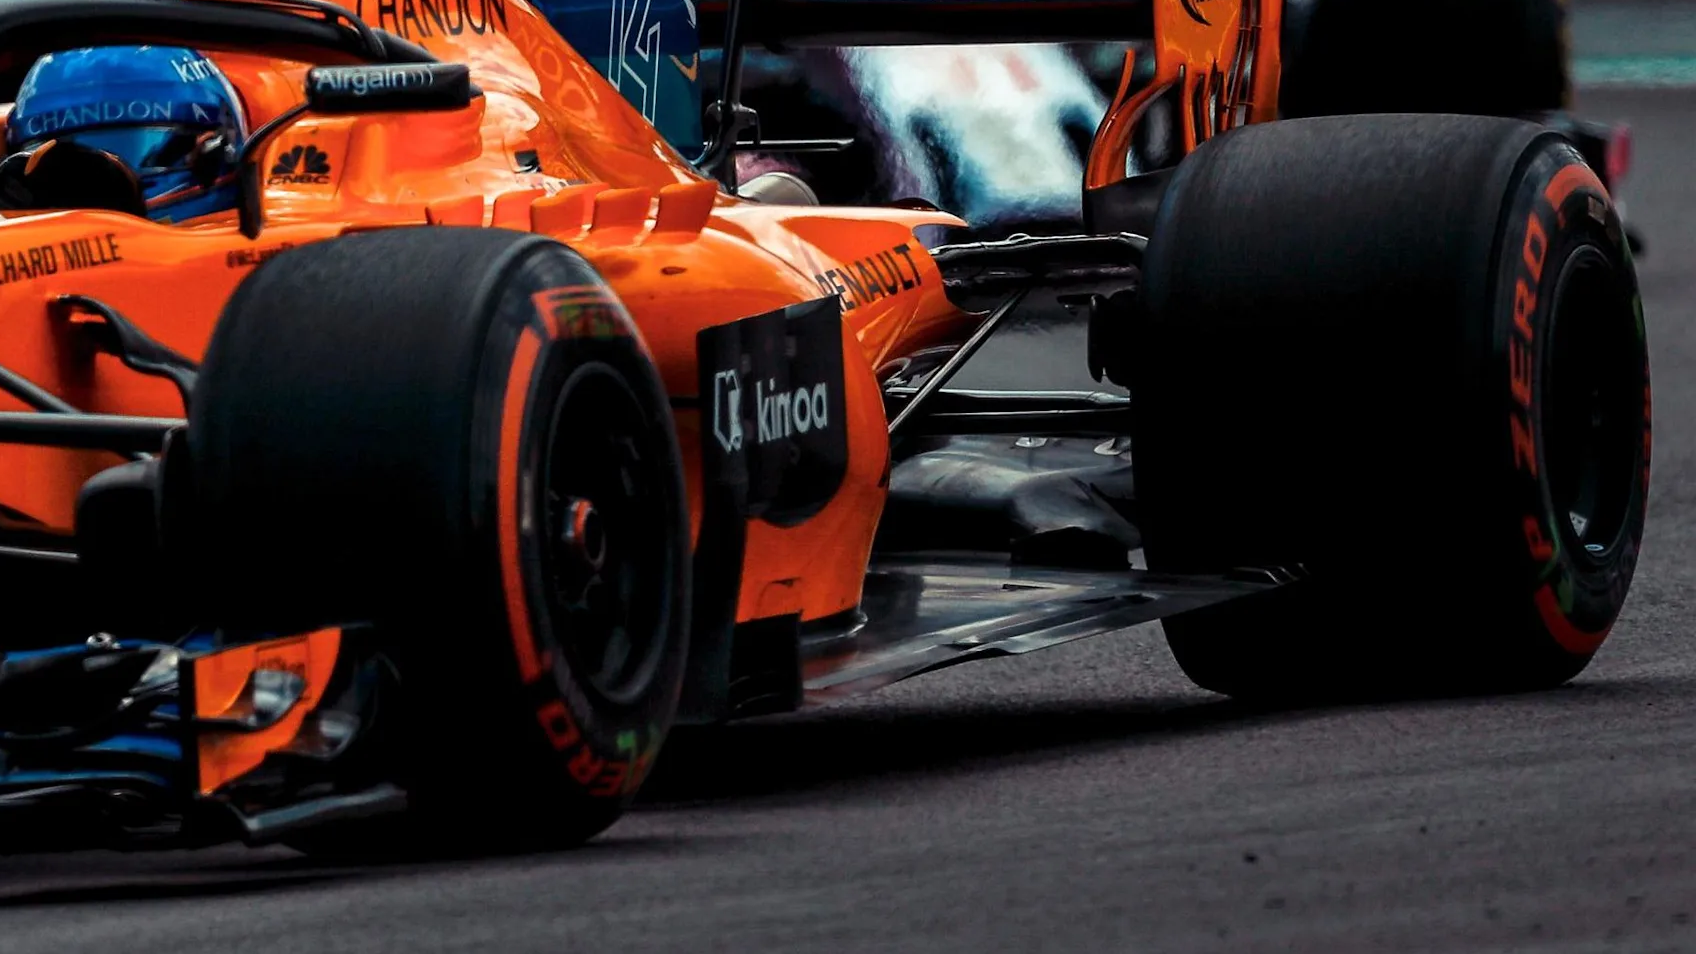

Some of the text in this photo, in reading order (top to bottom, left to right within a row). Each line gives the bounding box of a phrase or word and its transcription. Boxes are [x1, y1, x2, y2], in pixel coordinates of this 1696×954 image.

[171, 56, 218, 83] kim
[316, 67, 405, 94] Airgain
[27, 99, 172, 136] CHANDON
[267, 174, 329, 184] CNBC
[64, 235, 122, 271] MILLE
[1510, 212, 1547, 477] ZERO
